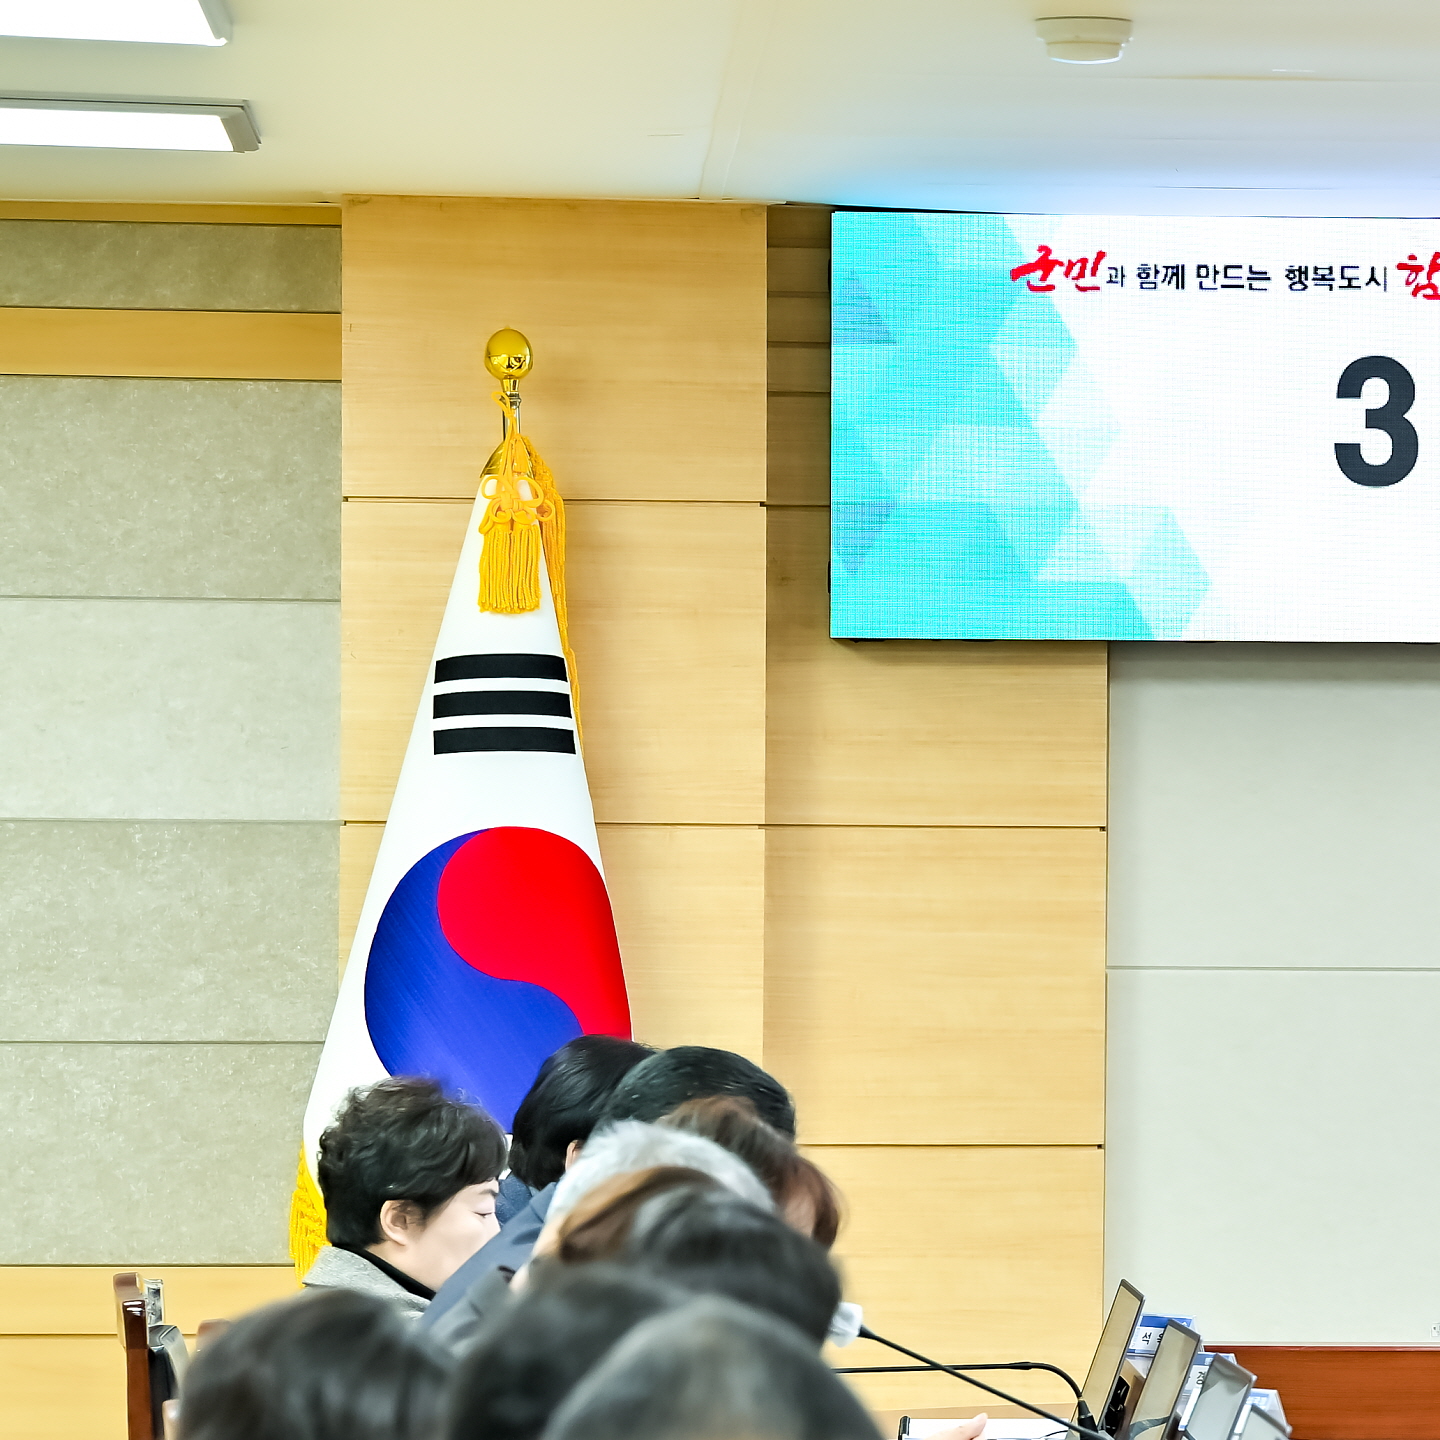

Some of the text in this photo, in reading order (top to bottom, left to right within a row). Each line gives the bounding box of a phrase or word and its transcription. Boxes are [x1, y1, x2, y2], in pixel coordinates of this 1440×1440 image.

[1136, 264, 1187, 292] 함께
[1195, 265, 1273, 292] 만드는
[1284, 266, 1389, 293] 행복도시
